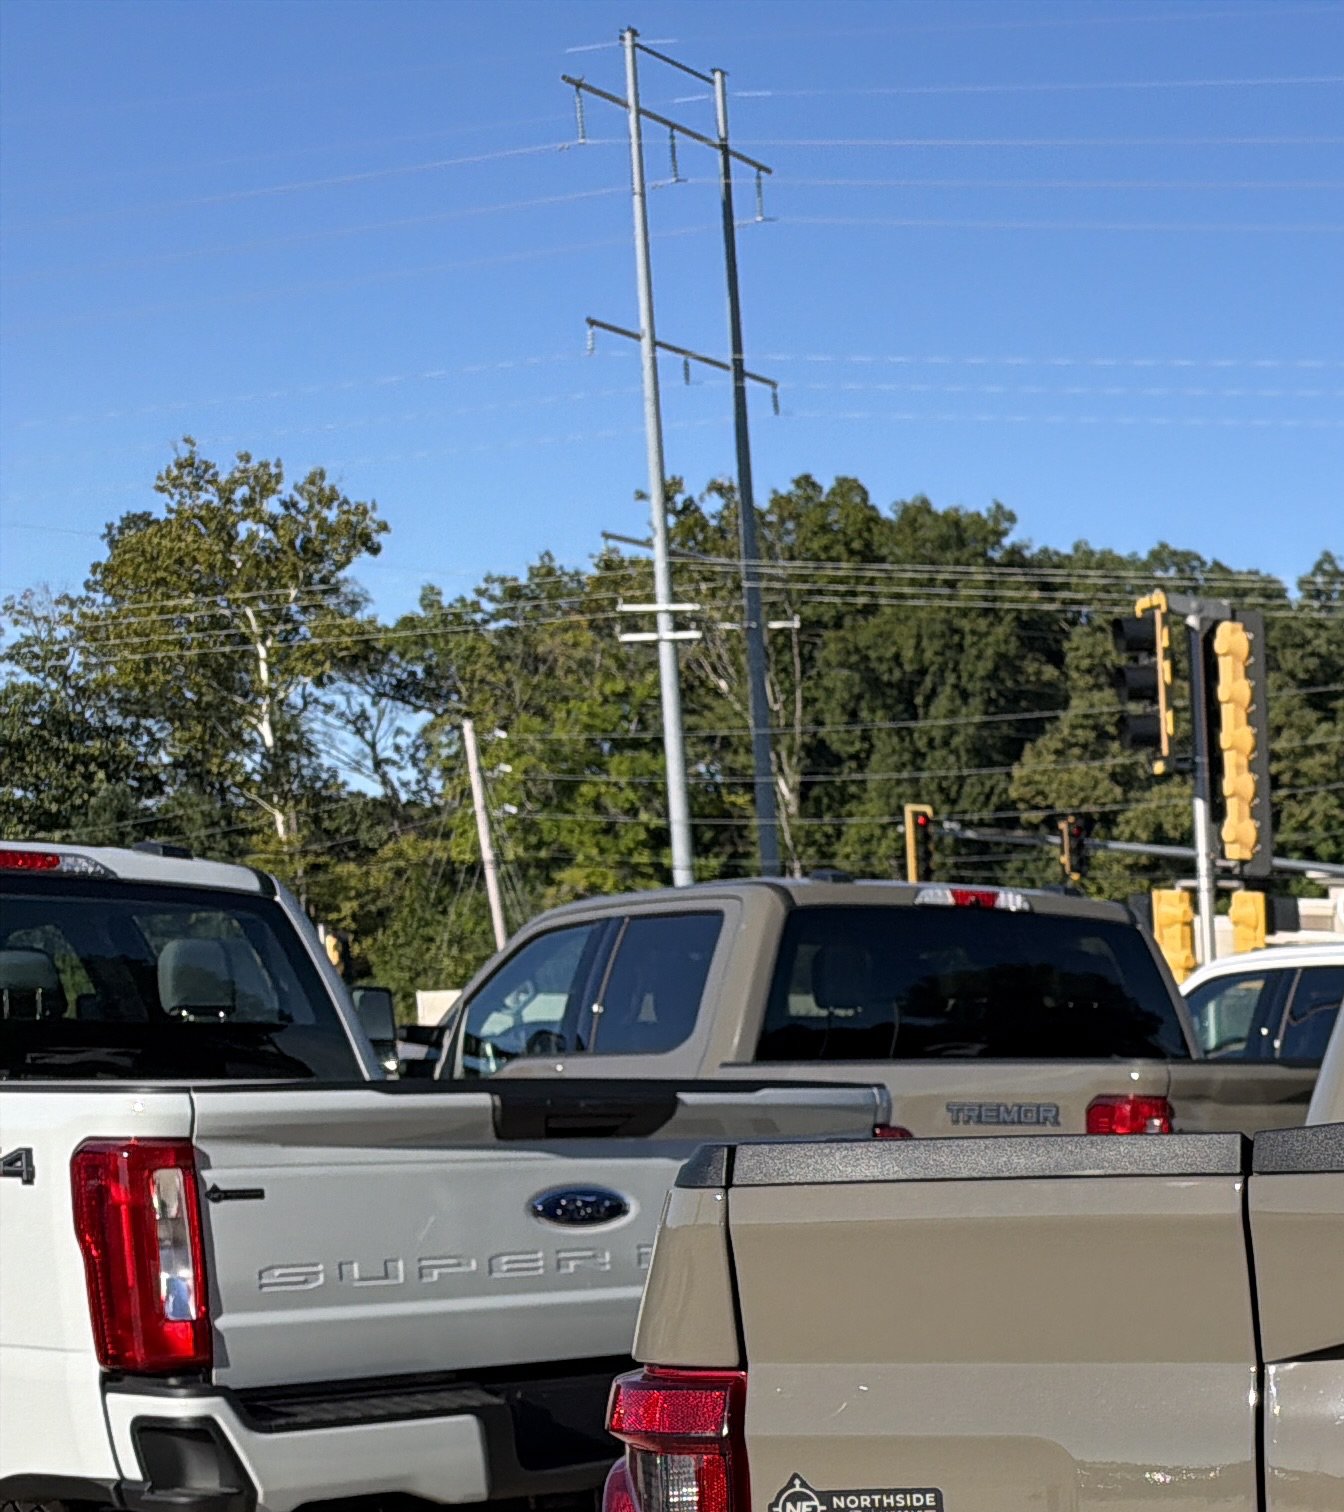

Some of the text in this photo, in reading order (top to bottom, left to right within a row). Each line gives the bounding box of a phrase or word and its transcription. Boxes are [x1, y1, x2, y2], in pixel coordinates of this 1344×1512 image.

[946, 1102, 1061, 1127] TREMOR
[0, 1147, 35, 1186] 4
[258, 1246, 611, 1293] SUPER
[832, 1493, 936, 1509] NORTHSIDE
